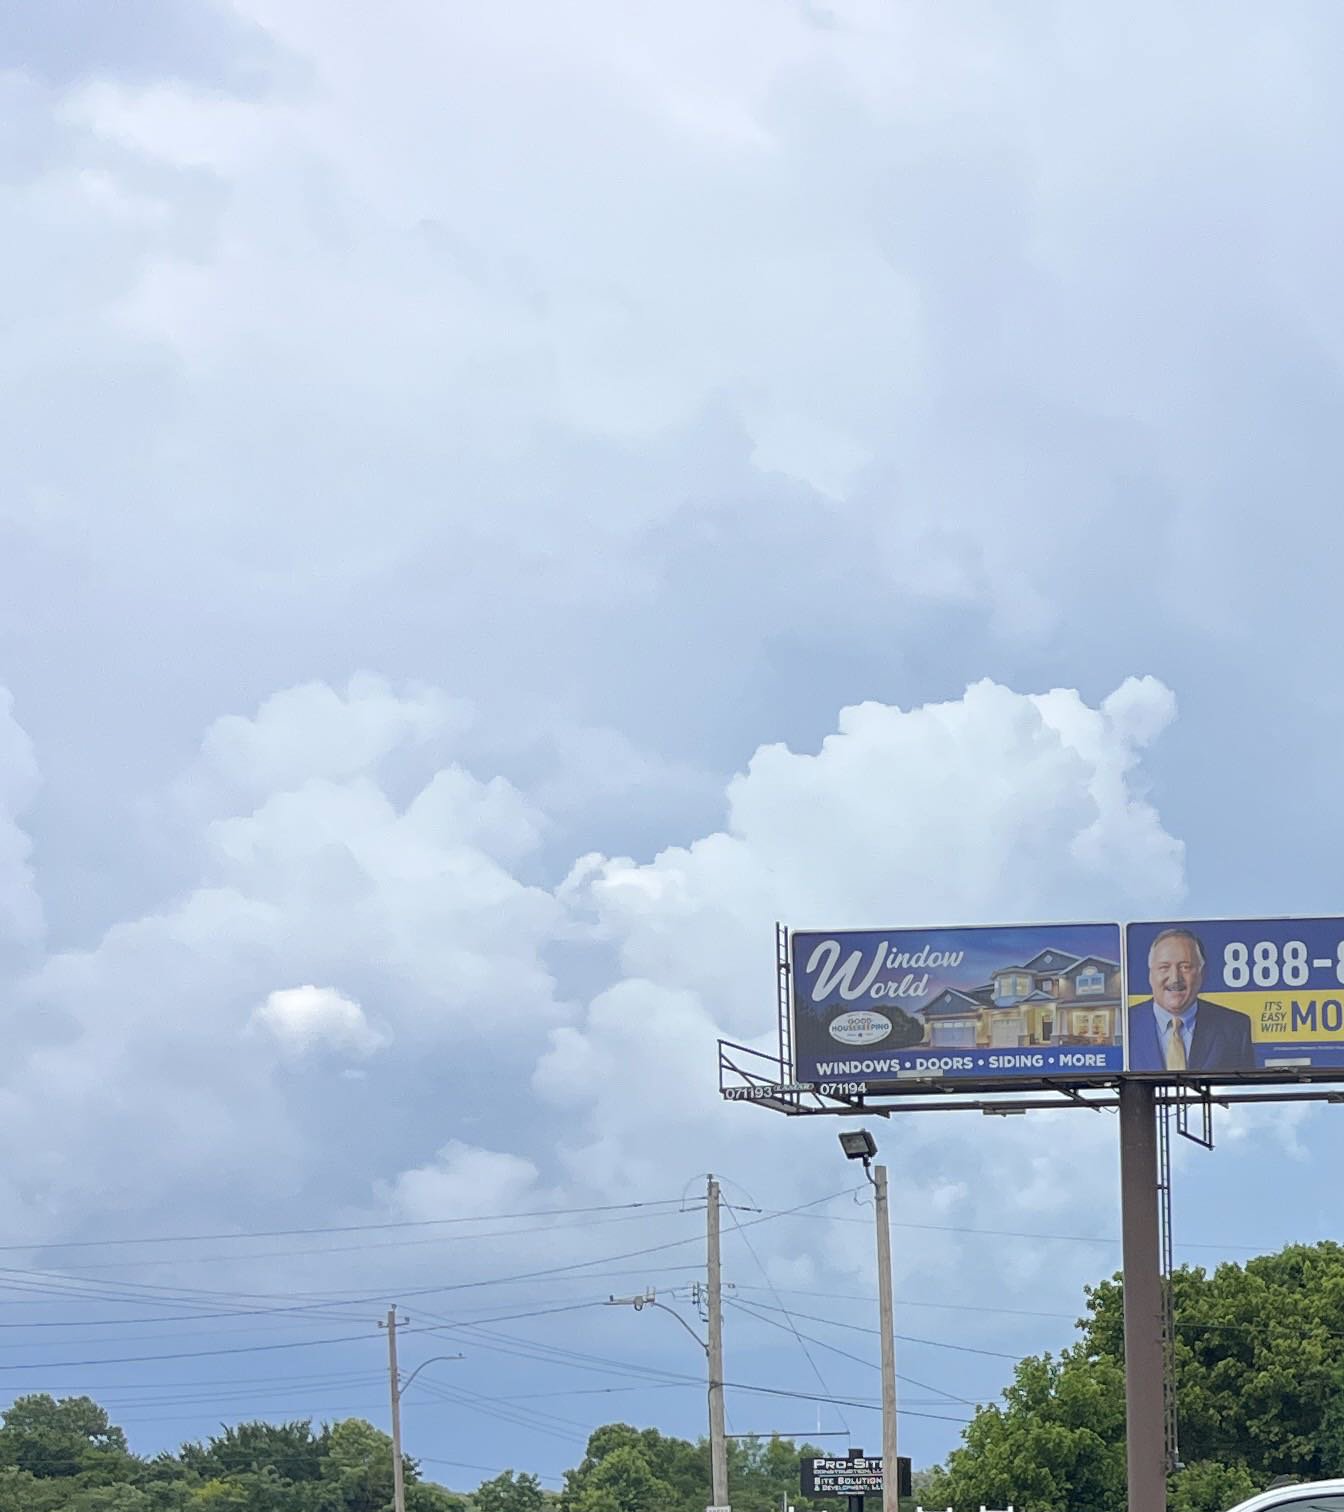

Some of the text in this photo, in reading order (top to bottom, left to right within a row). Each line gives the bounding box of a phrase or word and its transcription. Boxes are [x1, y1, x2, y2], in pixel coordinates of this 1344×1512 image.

[806, 939, 964, 1002] Window
[1263, 1001, 1283, 1012] IT'S
[1261, 1011, 1287, 1022] EASY
[1261, 1022, 1287, 1033] WITH
[816, 1053, 1106, 1076] WINDOWS DOORS SIDING MORE
[725, 1086, 773, 1100] 071193
[820, 1082, 867, 1095] 071194
[837, 1476, 883, 1485] SOLUTION
